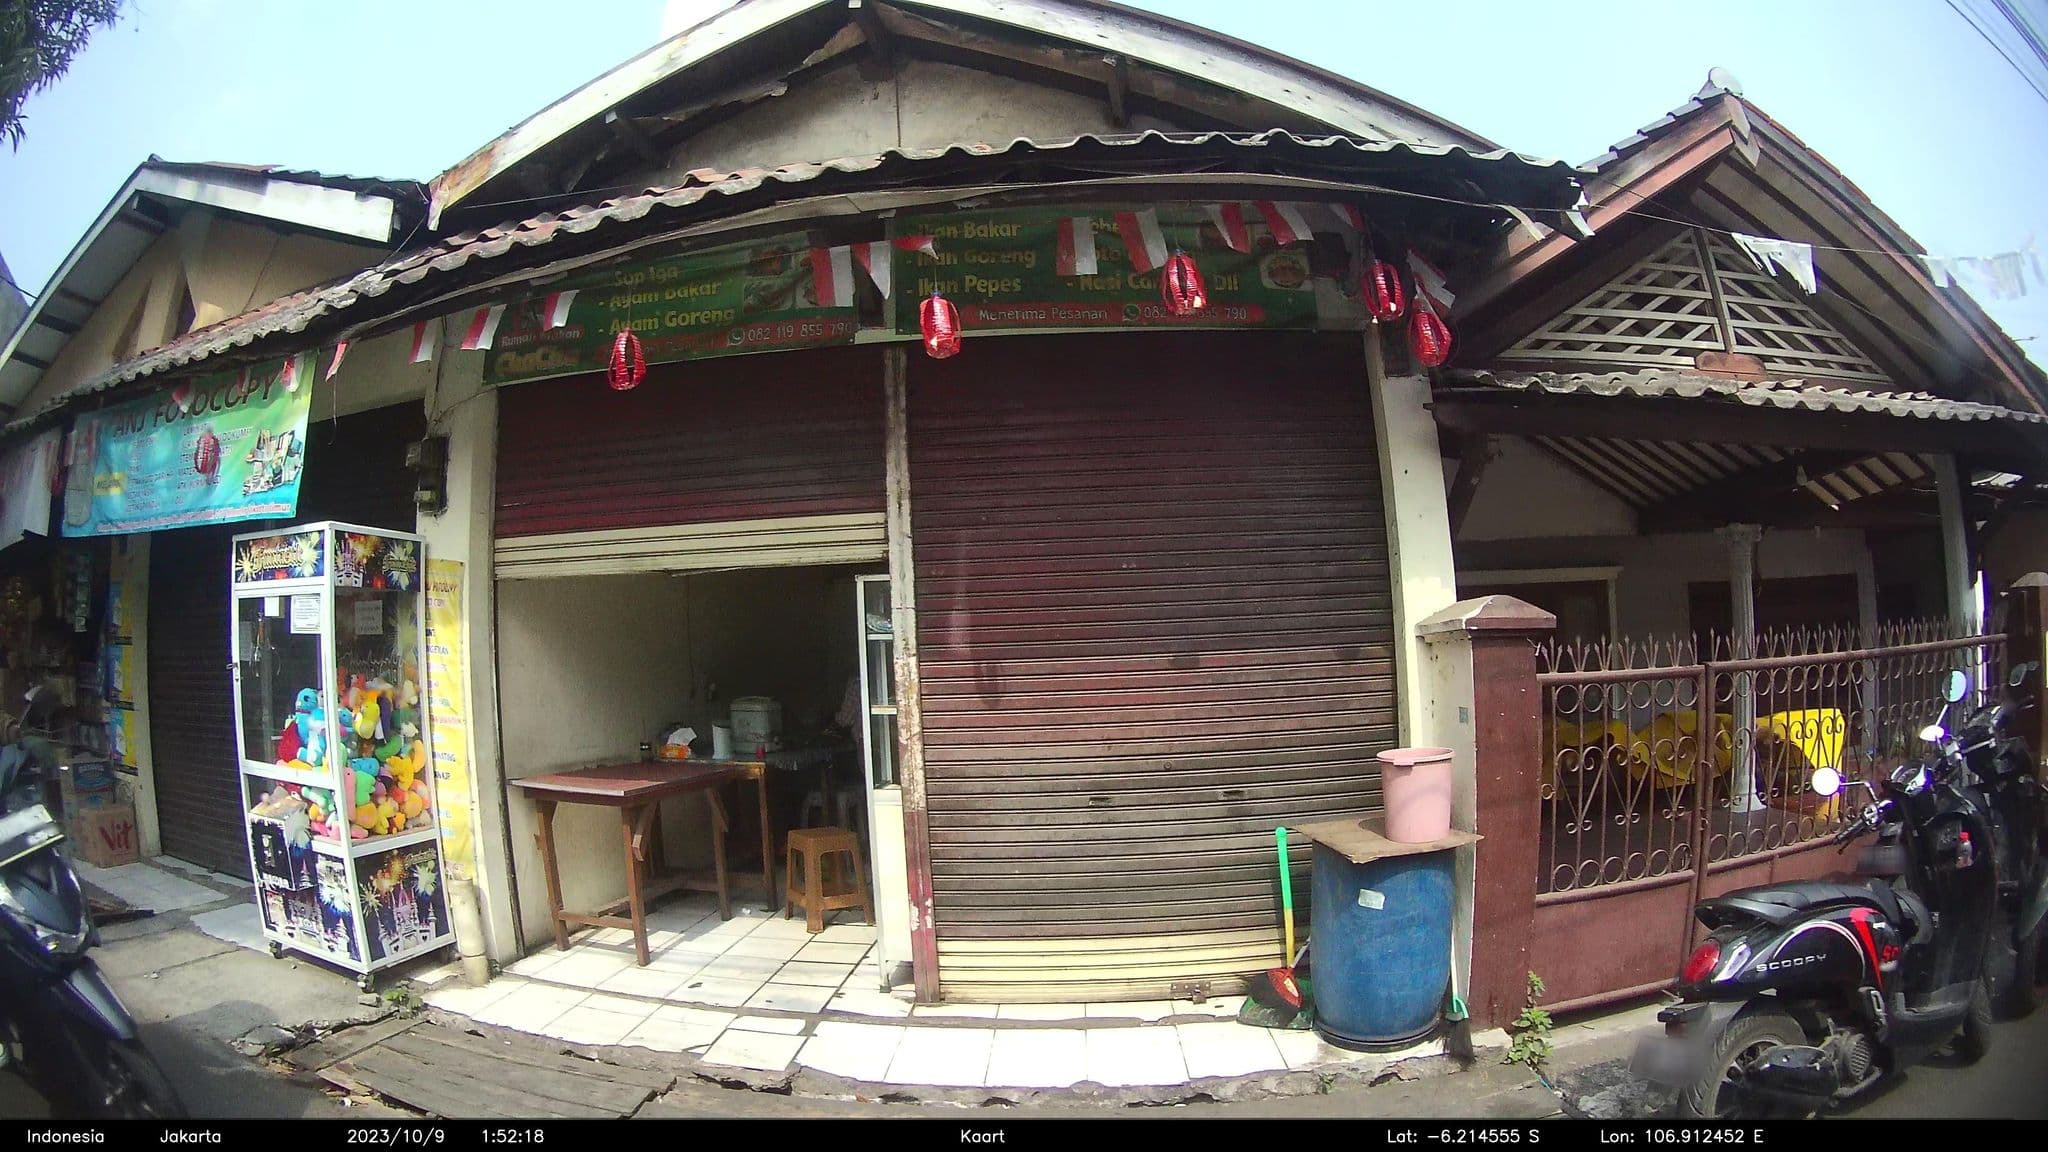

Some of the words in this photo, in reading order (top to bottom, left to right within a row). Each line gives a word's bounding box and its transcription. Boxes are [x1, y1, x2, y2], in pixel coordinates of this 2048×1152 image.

[963, 219, 1022, 239] Bakar
[964, 248, 1037, 269] Goreng
[964, 274, 1023, 298] Pepes
[664, 307, 737, 329] Goreng
[979, 307, 1047, 321] Menerima
[1051, 306, 1108, 321] Pesanan
[1224, 306, 1248, 320] 790
[748, 327, 771, 341] 082
[776, 324, 795, 338] 119
[801, 323, 823, 337] 855
[99, 819, 134, 851] Vit
[1756, 953, 1827, 972] SCOOPY
